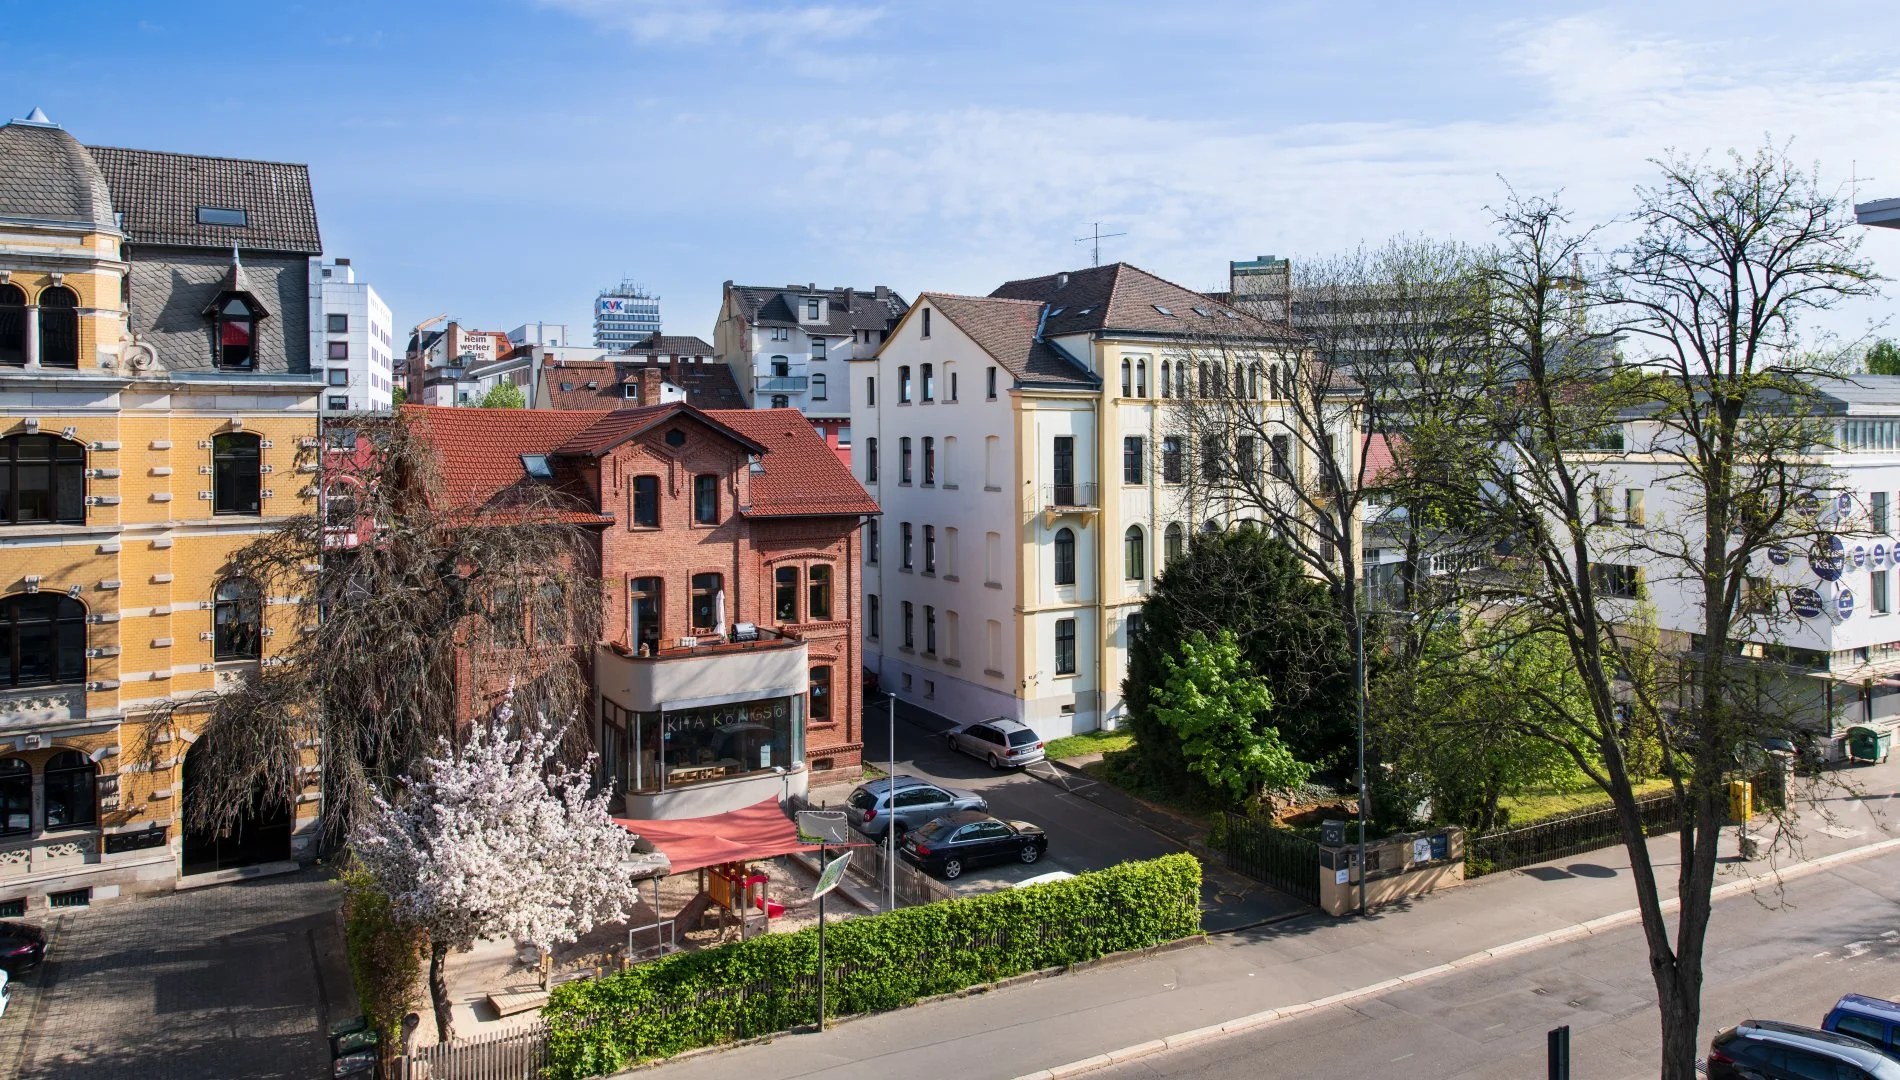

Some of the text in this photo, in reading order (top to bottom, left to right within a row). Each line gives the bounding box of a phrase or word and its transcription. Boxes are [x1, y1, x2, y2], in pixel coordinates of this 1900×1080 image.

[602, 300, 623, 310] KVK
[464, 335, 487, 343] Heim
[460, 343, 490, 351] werker
[666, 714, 705, 732] KITA
